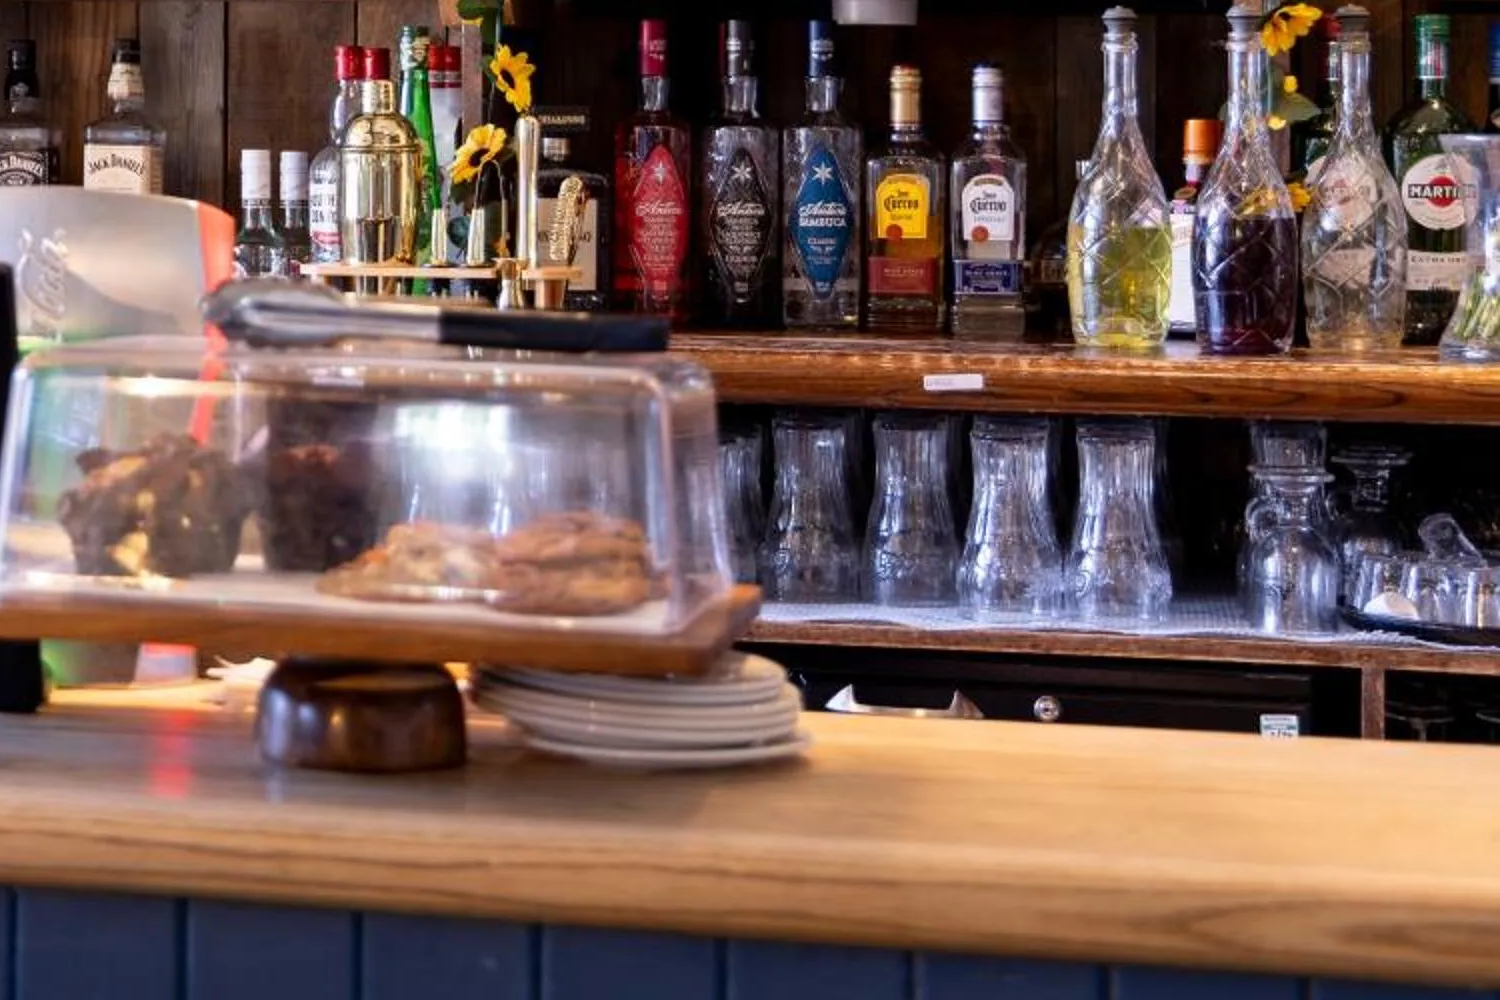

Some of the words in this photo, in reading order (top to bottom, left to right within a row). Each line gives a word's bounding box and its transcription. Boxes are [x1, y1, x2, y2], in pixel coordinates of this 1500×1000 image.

[883, 196, 919, 211] Cuervo
[970, 197, 1007, 213] Cuervo
[799, 217, 846, 228] SAMBUCA
